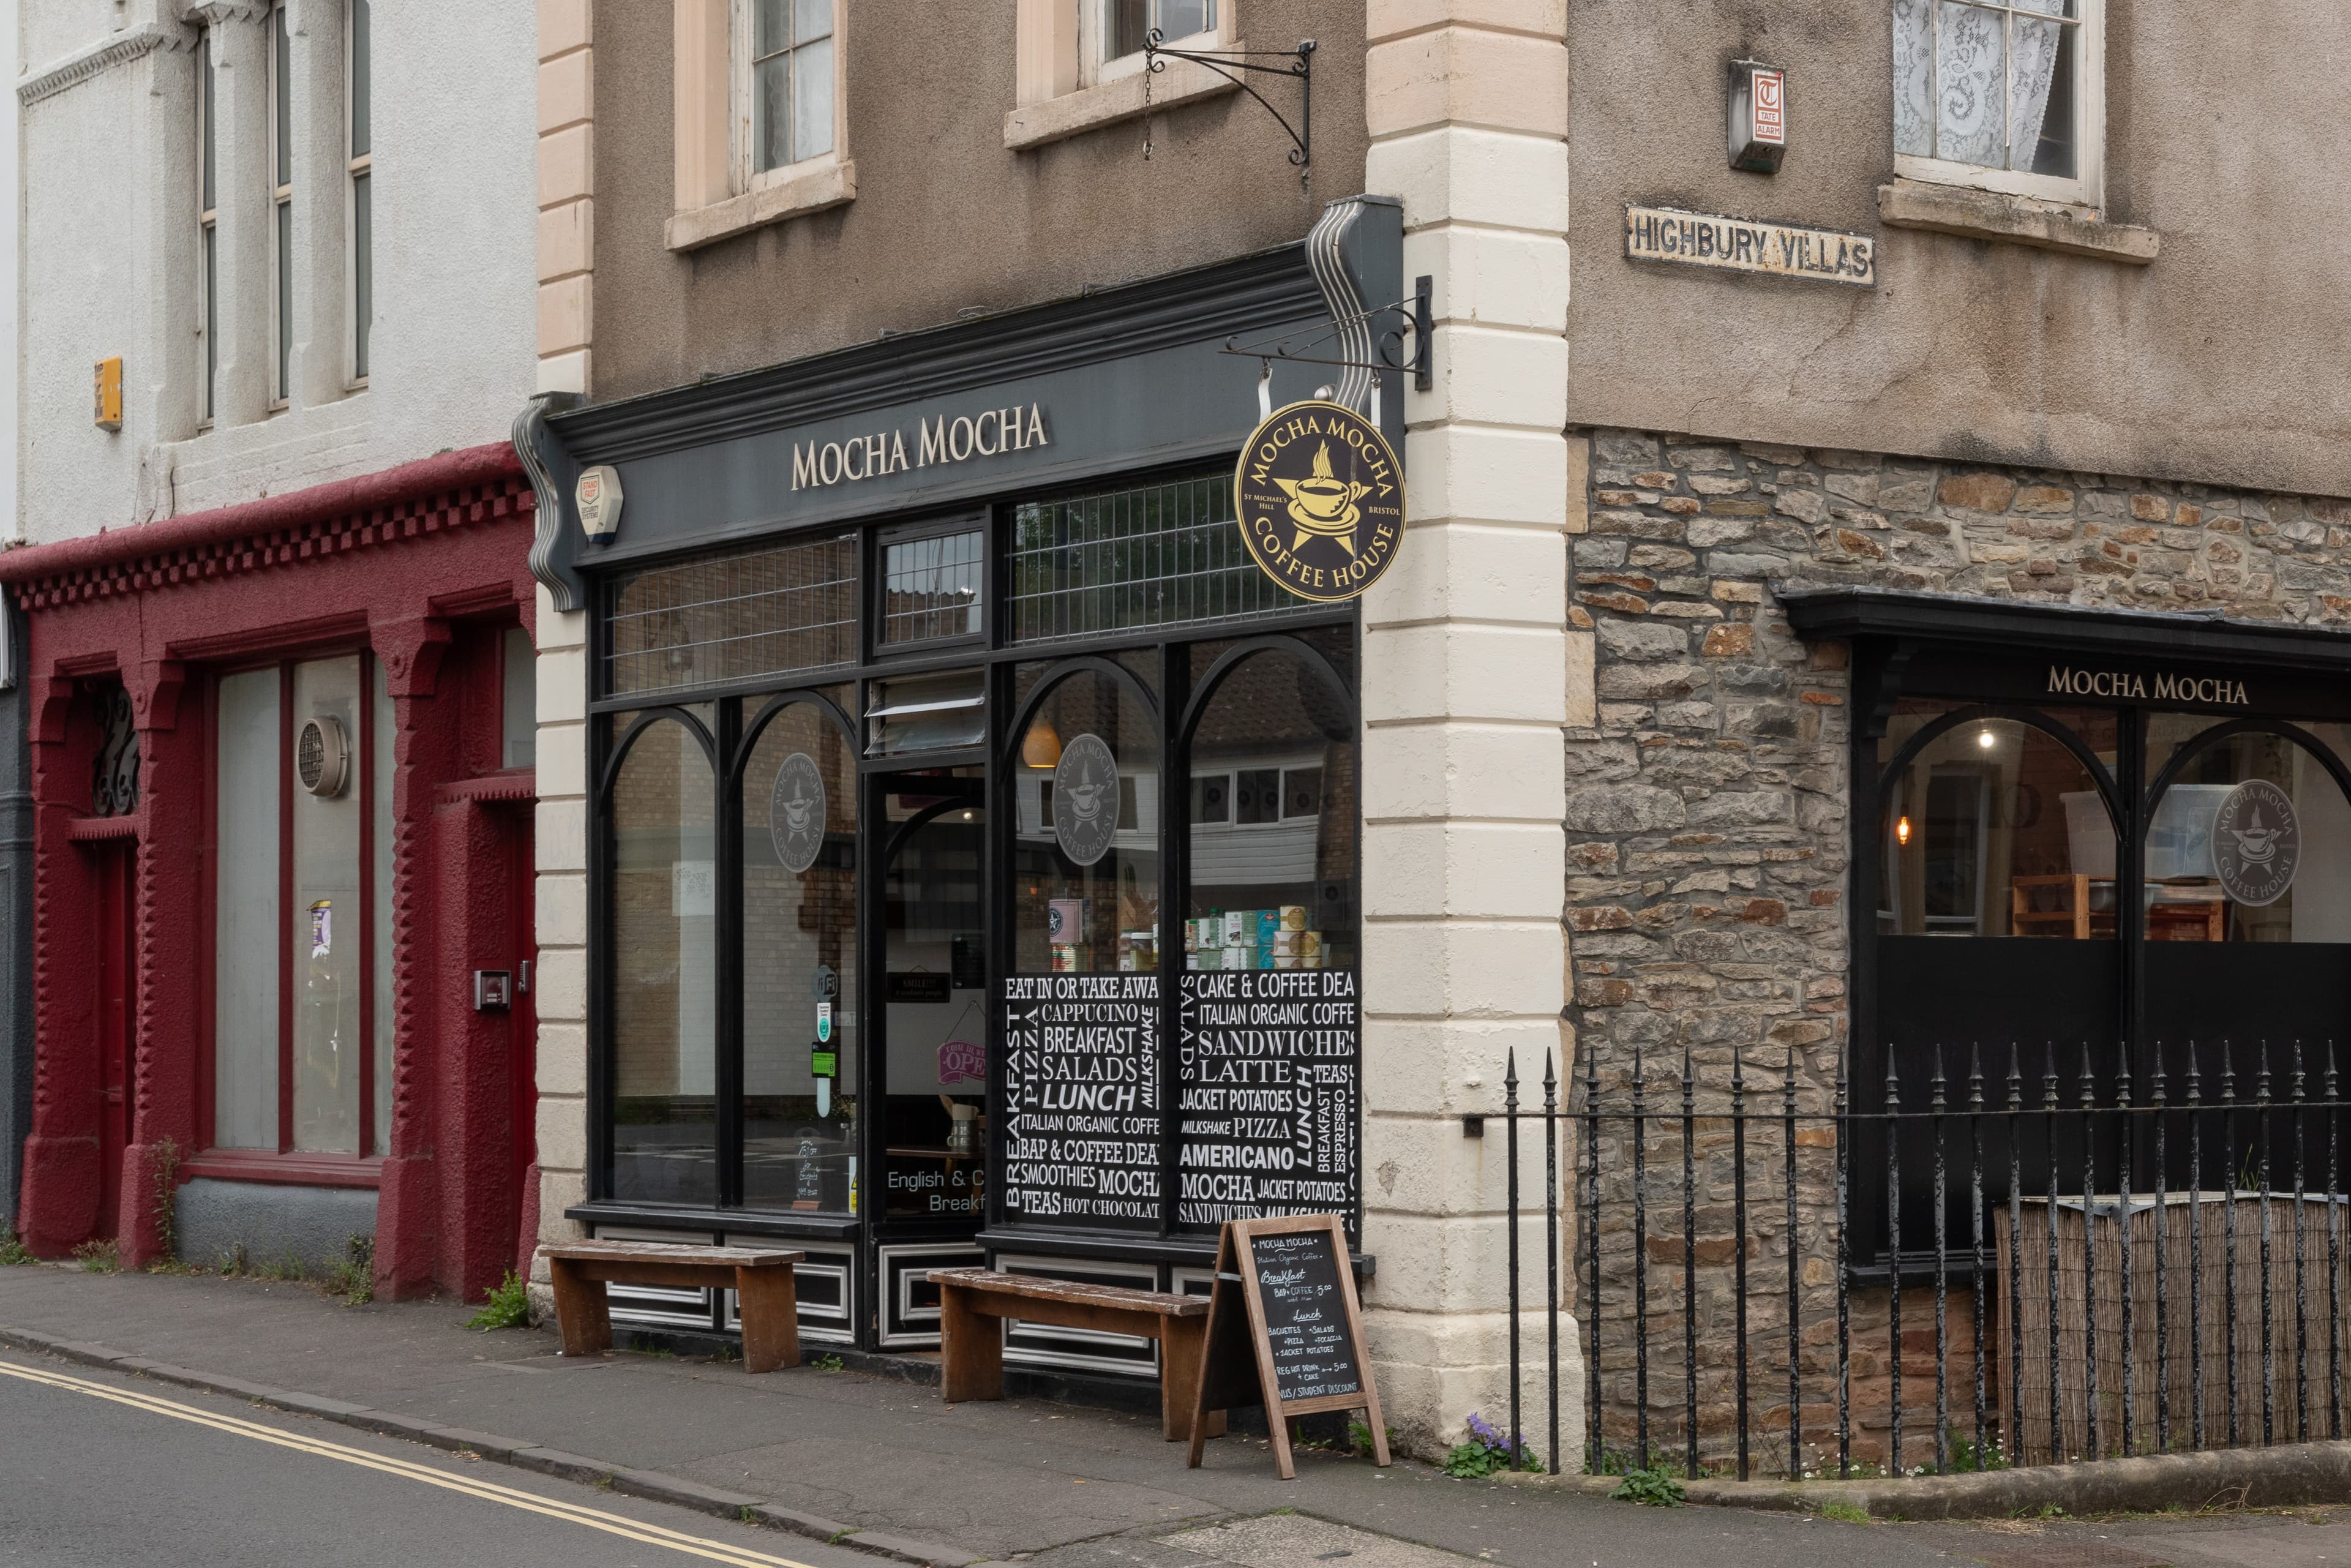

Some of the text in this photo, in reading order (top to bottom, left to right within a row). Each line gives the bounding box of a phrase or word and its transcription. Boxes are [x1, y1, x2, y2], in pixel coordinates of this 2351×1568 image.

[1761, 112, 1776, 121] TATE
[1757, 125, 1780, 136] ALARM
[1635, 215, 1869, 277] HIGHBURY VILLAS
[790, 402, 1049, 491] MOCHA MOCHA
[1250, 416, 1393, 498] MOCHA MOCHA
[583, 481, 598, 490] STAND
[585, 489, 595, 498] FAST
[582, 505, 599, 514] SECURITY
[1254, 494, 1288, 503] MICHAEL'S
[1368, 506, 1401, 516] BRISTOL
[1255, 517, 1394, 588] COFFEE HOUSE
[2047, 666, 2249, 704] MOCHA MOCHA
[1058, 743, 1113, 792] MOCHA MOCHA
[2219, 788, 2293, 836] MOCHA MOCHA
[1059, 811, 1113, 857] COFFEE HOUSE
[775, 828, 798, 865] COFFEE
[2220, 856, 2292, 898] COFFEE HOUSE
[1005, 978, 1034, 999] EAT
[1037, 978, 1053, 999] IN
[1056, 977, 1078, 999] OR
[1080, 977, 1119, 999] TAKE
[1197, 974, 1236, 998] CAKE
[1241, 973, 1253, 998] &
[1258, 973, 1318, 998] COFFEE
[1042, 1003, 1138, 1022] CAPPUCINO
[1200, 1003, 1354, 1025] ITALIAN ORGANIC COFFE
[1180, 975, 1194, 1080] SALADS
[1044, 1027, 1137, 1054] BREAKFAST
[1024, 1006, 1038, 1106] PIZZA
[1141, 1005, 1153, 1108] MILKSHAKE
[1042, 1056, 1138, 1082] SALADS
[1199, 1059, 1292, 1083] LATTE
[1313, 1065, 1348, 1084] TEAS
[1007, 1005, 1020, 1207] BREAKFAST
[1043, 1084, 1136, 1111] LUNCH
[1179, 1089, 1292, 1112] JACKET POTATOES
[1021, 1114, 1063, 1131] ITALIAN
[1067, 1115, 1119, 1133] ORGANIC
[1181, 1117, 1292, 1139] MILKSHAKE PIZZA
[1297, 1065, 1311, 1167] LUNCH
[1318, 1087, 1330, 1172] BREAKFAST
[1335, 1089, 1346, 1174] ESPRESSO
[1020, 1138, 1048, 1160] BAP
[1050, 1139, 1061, 1160] &
[1064, 1140, 1123, 1163] COFFEE
[1179, 1144, 1294, 1170] AMERICANO
[888, 1171, 944, 1191] English
[951, 1171, 966, 1186] &
[1021, 1163, 1096, 1188] SMOOTHIES
[1180, 1173, 1346, 1202] MOCHA JACKET POTATOES
[1022, 1190, 1061, 1215] TEAS
[1063, 1198, 1090, 1214] HOT
[1259, 1237, 1313, 1249] MOCHA MOCHA
[1279, 1253, 1299, 1265] Organic
[1261, 1268, 1306, 1286] Breakfast
[1291, 1286, 1313, 1296] COFFEE
[1293, 1308, 1322, 1321] Lunch
[1268, 1326, 1335, 1336] BAGUETTES SALADS
[1287, 1335, 1342, 1346] PIZZA FOCACCIA
[1280, 1346, 1334, 1357] JACKET POTATOES
[1291, 1365, 1300, 1373] HOT
[1328, 1382, 1357, 1394] DISCOUNT
